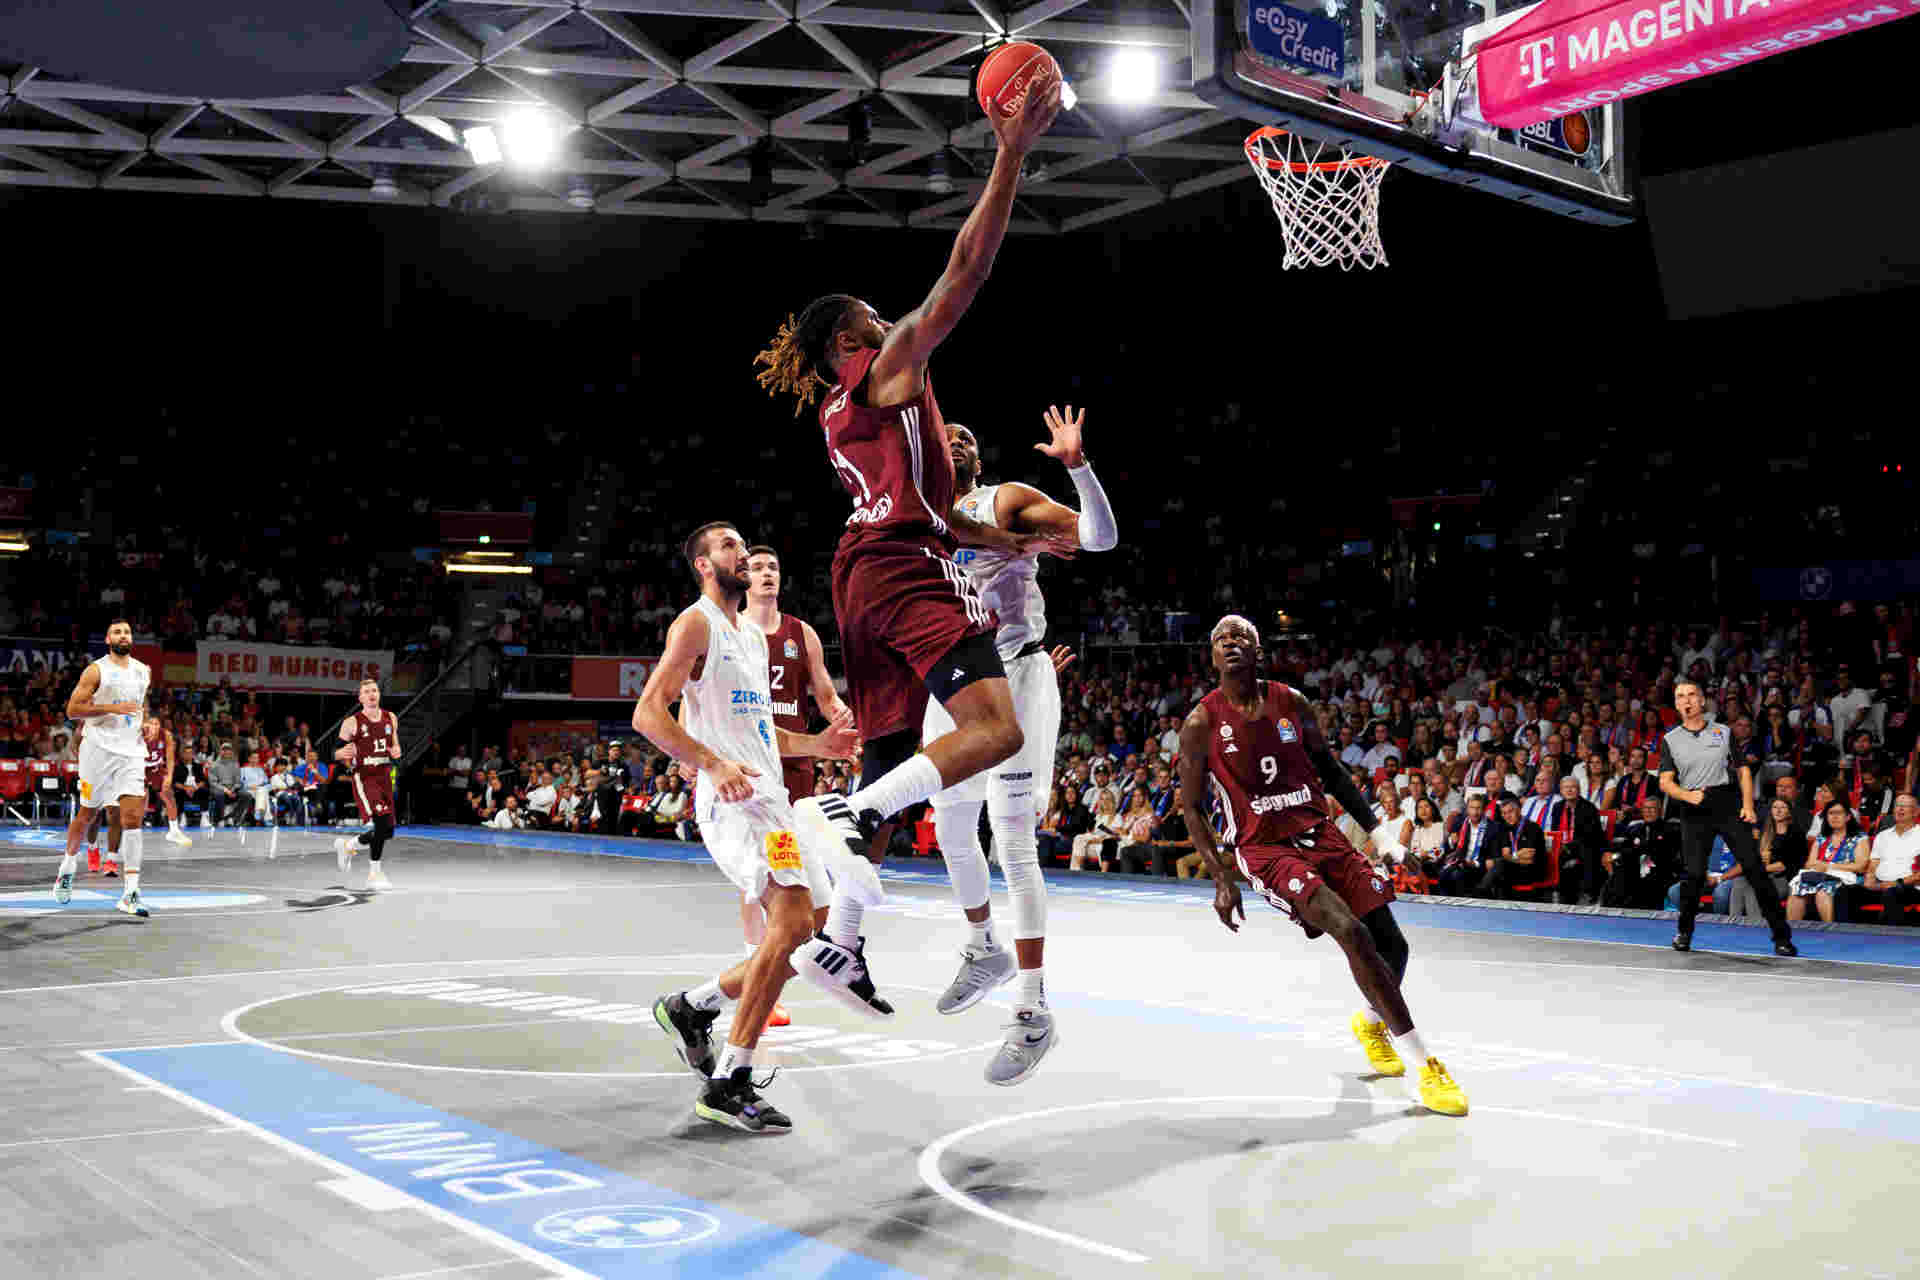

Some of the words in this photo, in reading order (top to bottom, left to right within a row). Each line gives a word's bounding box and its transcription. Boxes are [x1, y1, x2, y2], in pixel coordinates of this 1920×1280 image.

[1280, 34, 1338, 72] Credit
[1668, 6, 1899, 75] MAGENTA
[208, 653, 257, 674] RED
[1260, 755, 1278, 785] 9
[307, 1121, 605, 1202] BMW
